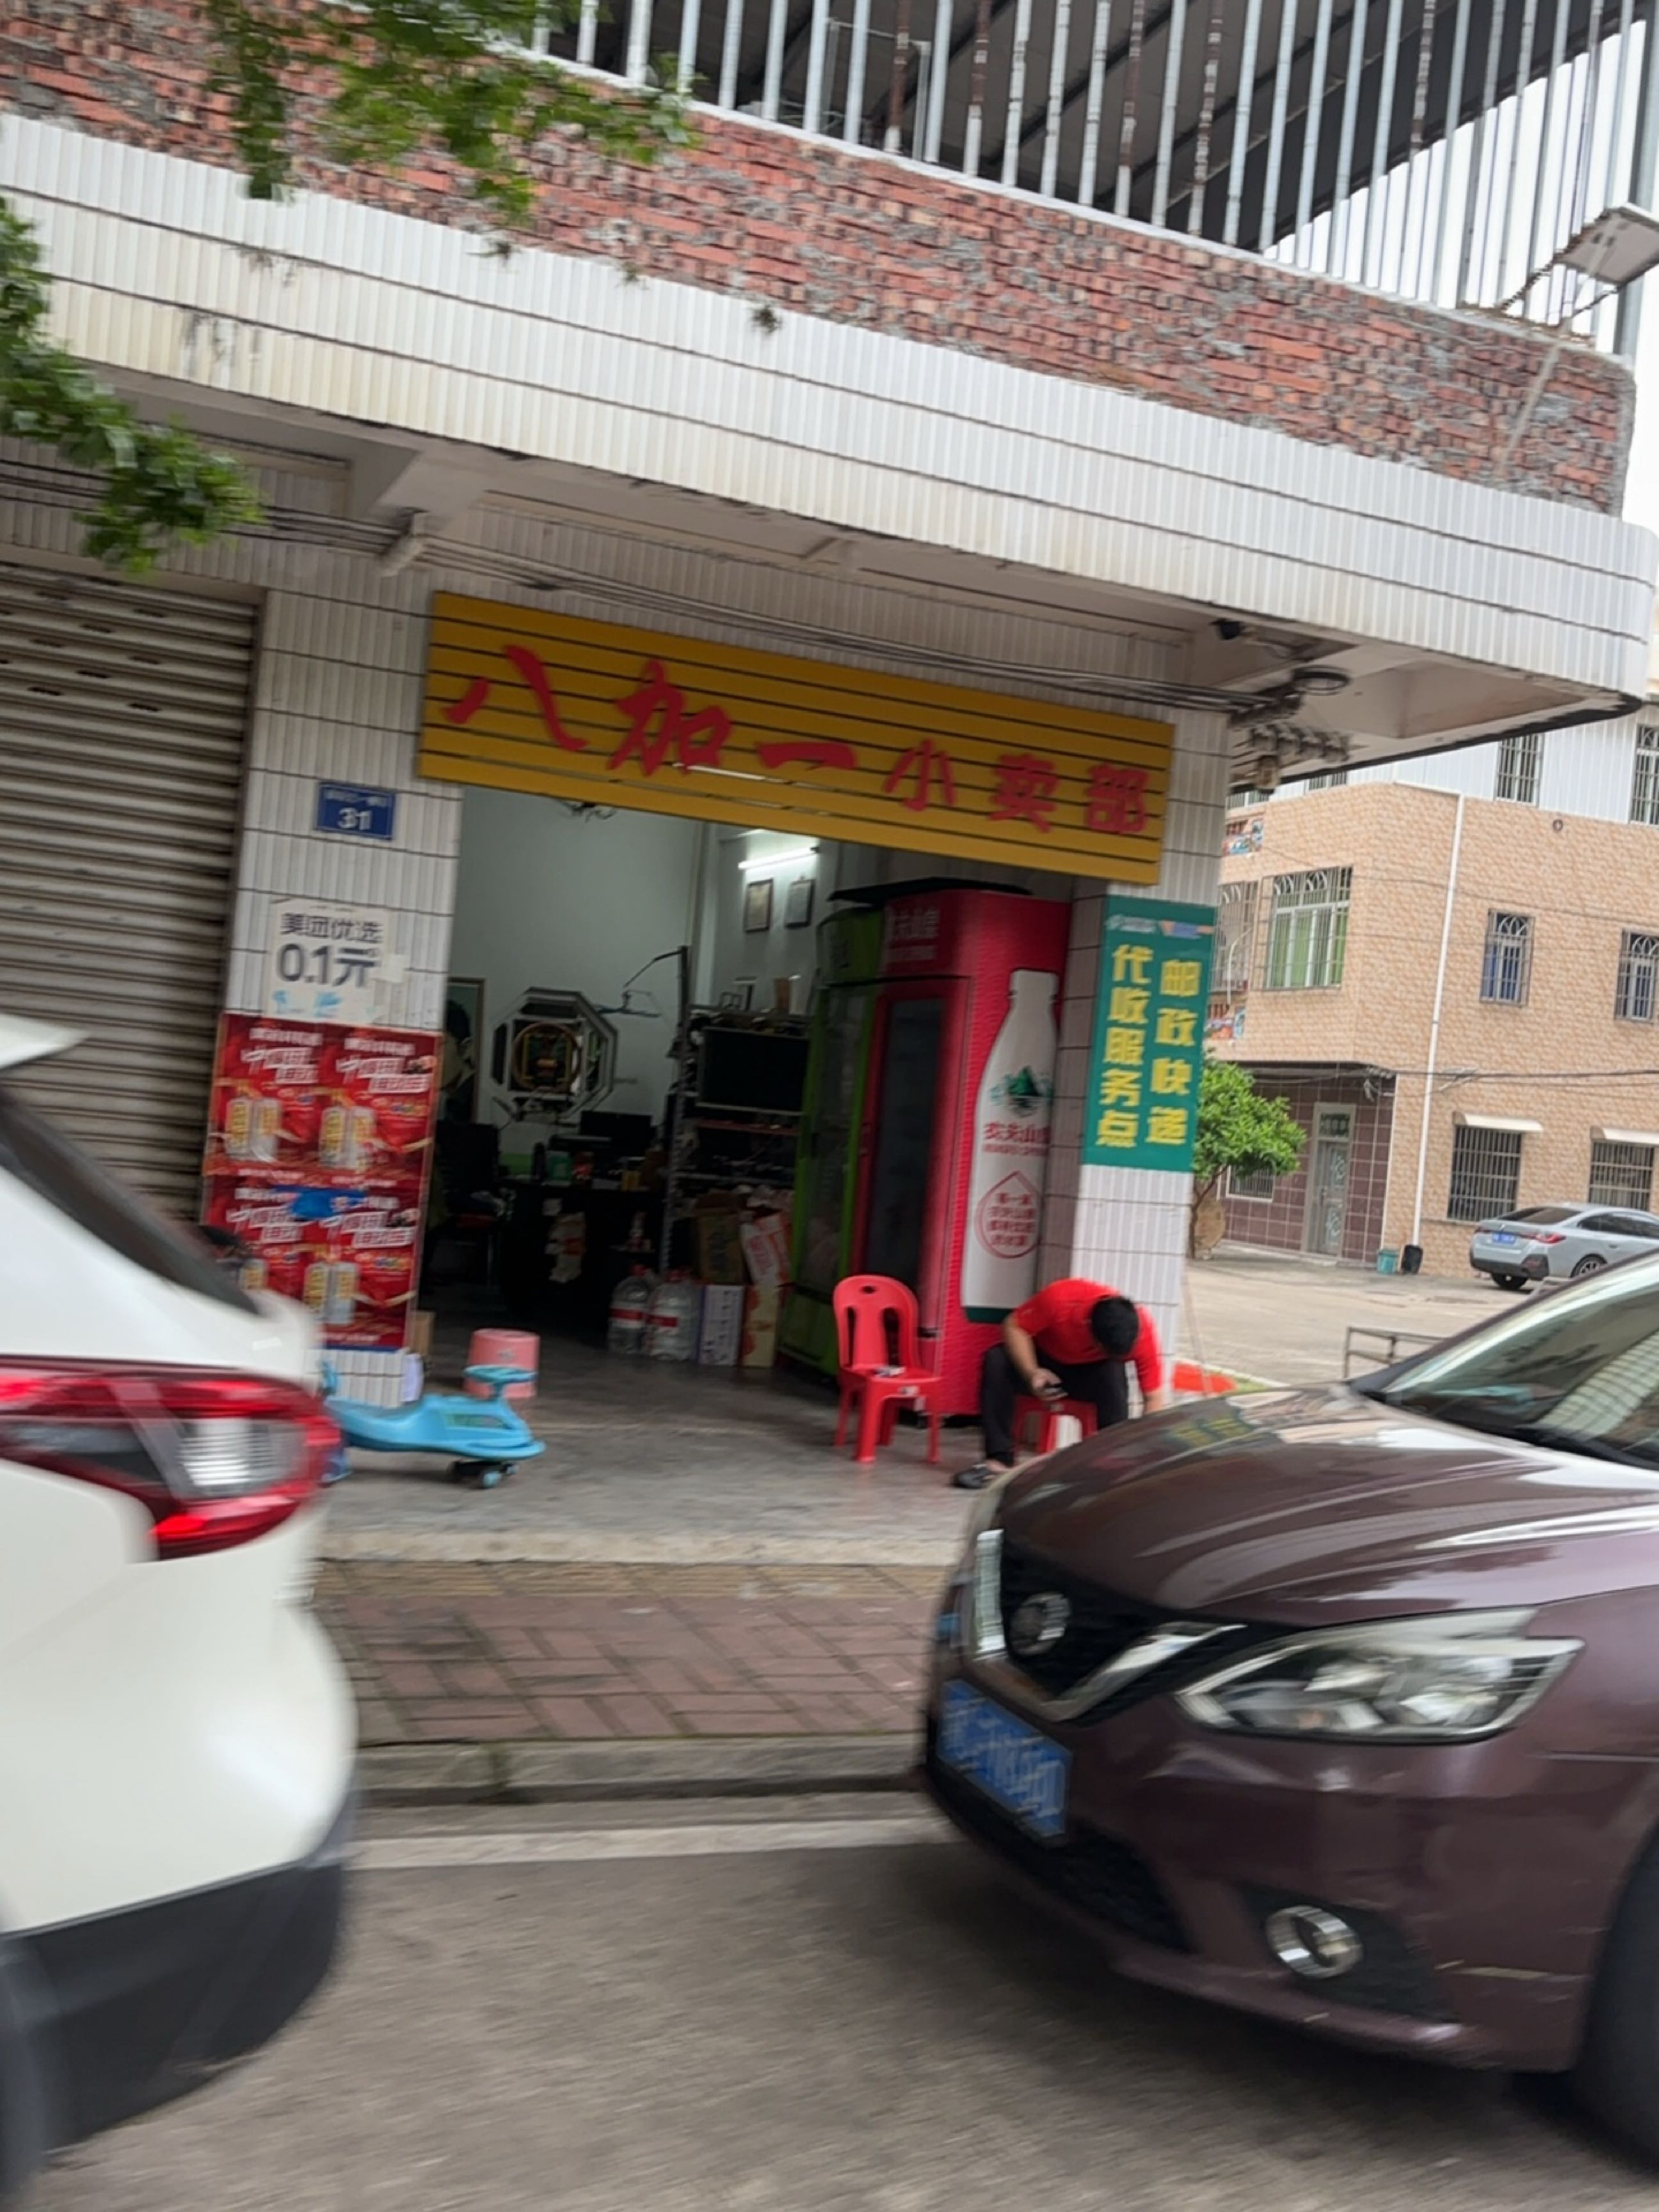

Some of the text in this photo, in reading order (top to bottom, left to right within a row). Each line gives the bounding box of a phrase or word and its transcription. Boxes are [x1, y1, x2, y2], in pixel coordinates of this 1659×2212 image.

[442, 643, 1150, 835] 八加一小卖部
[337, 808, 373, 830] 31
[280, 911, 383, 943] 美团优选
[277, 943, 381, 988] 0.1元
[1145, 959, 1202, 1146] 邮政快递
